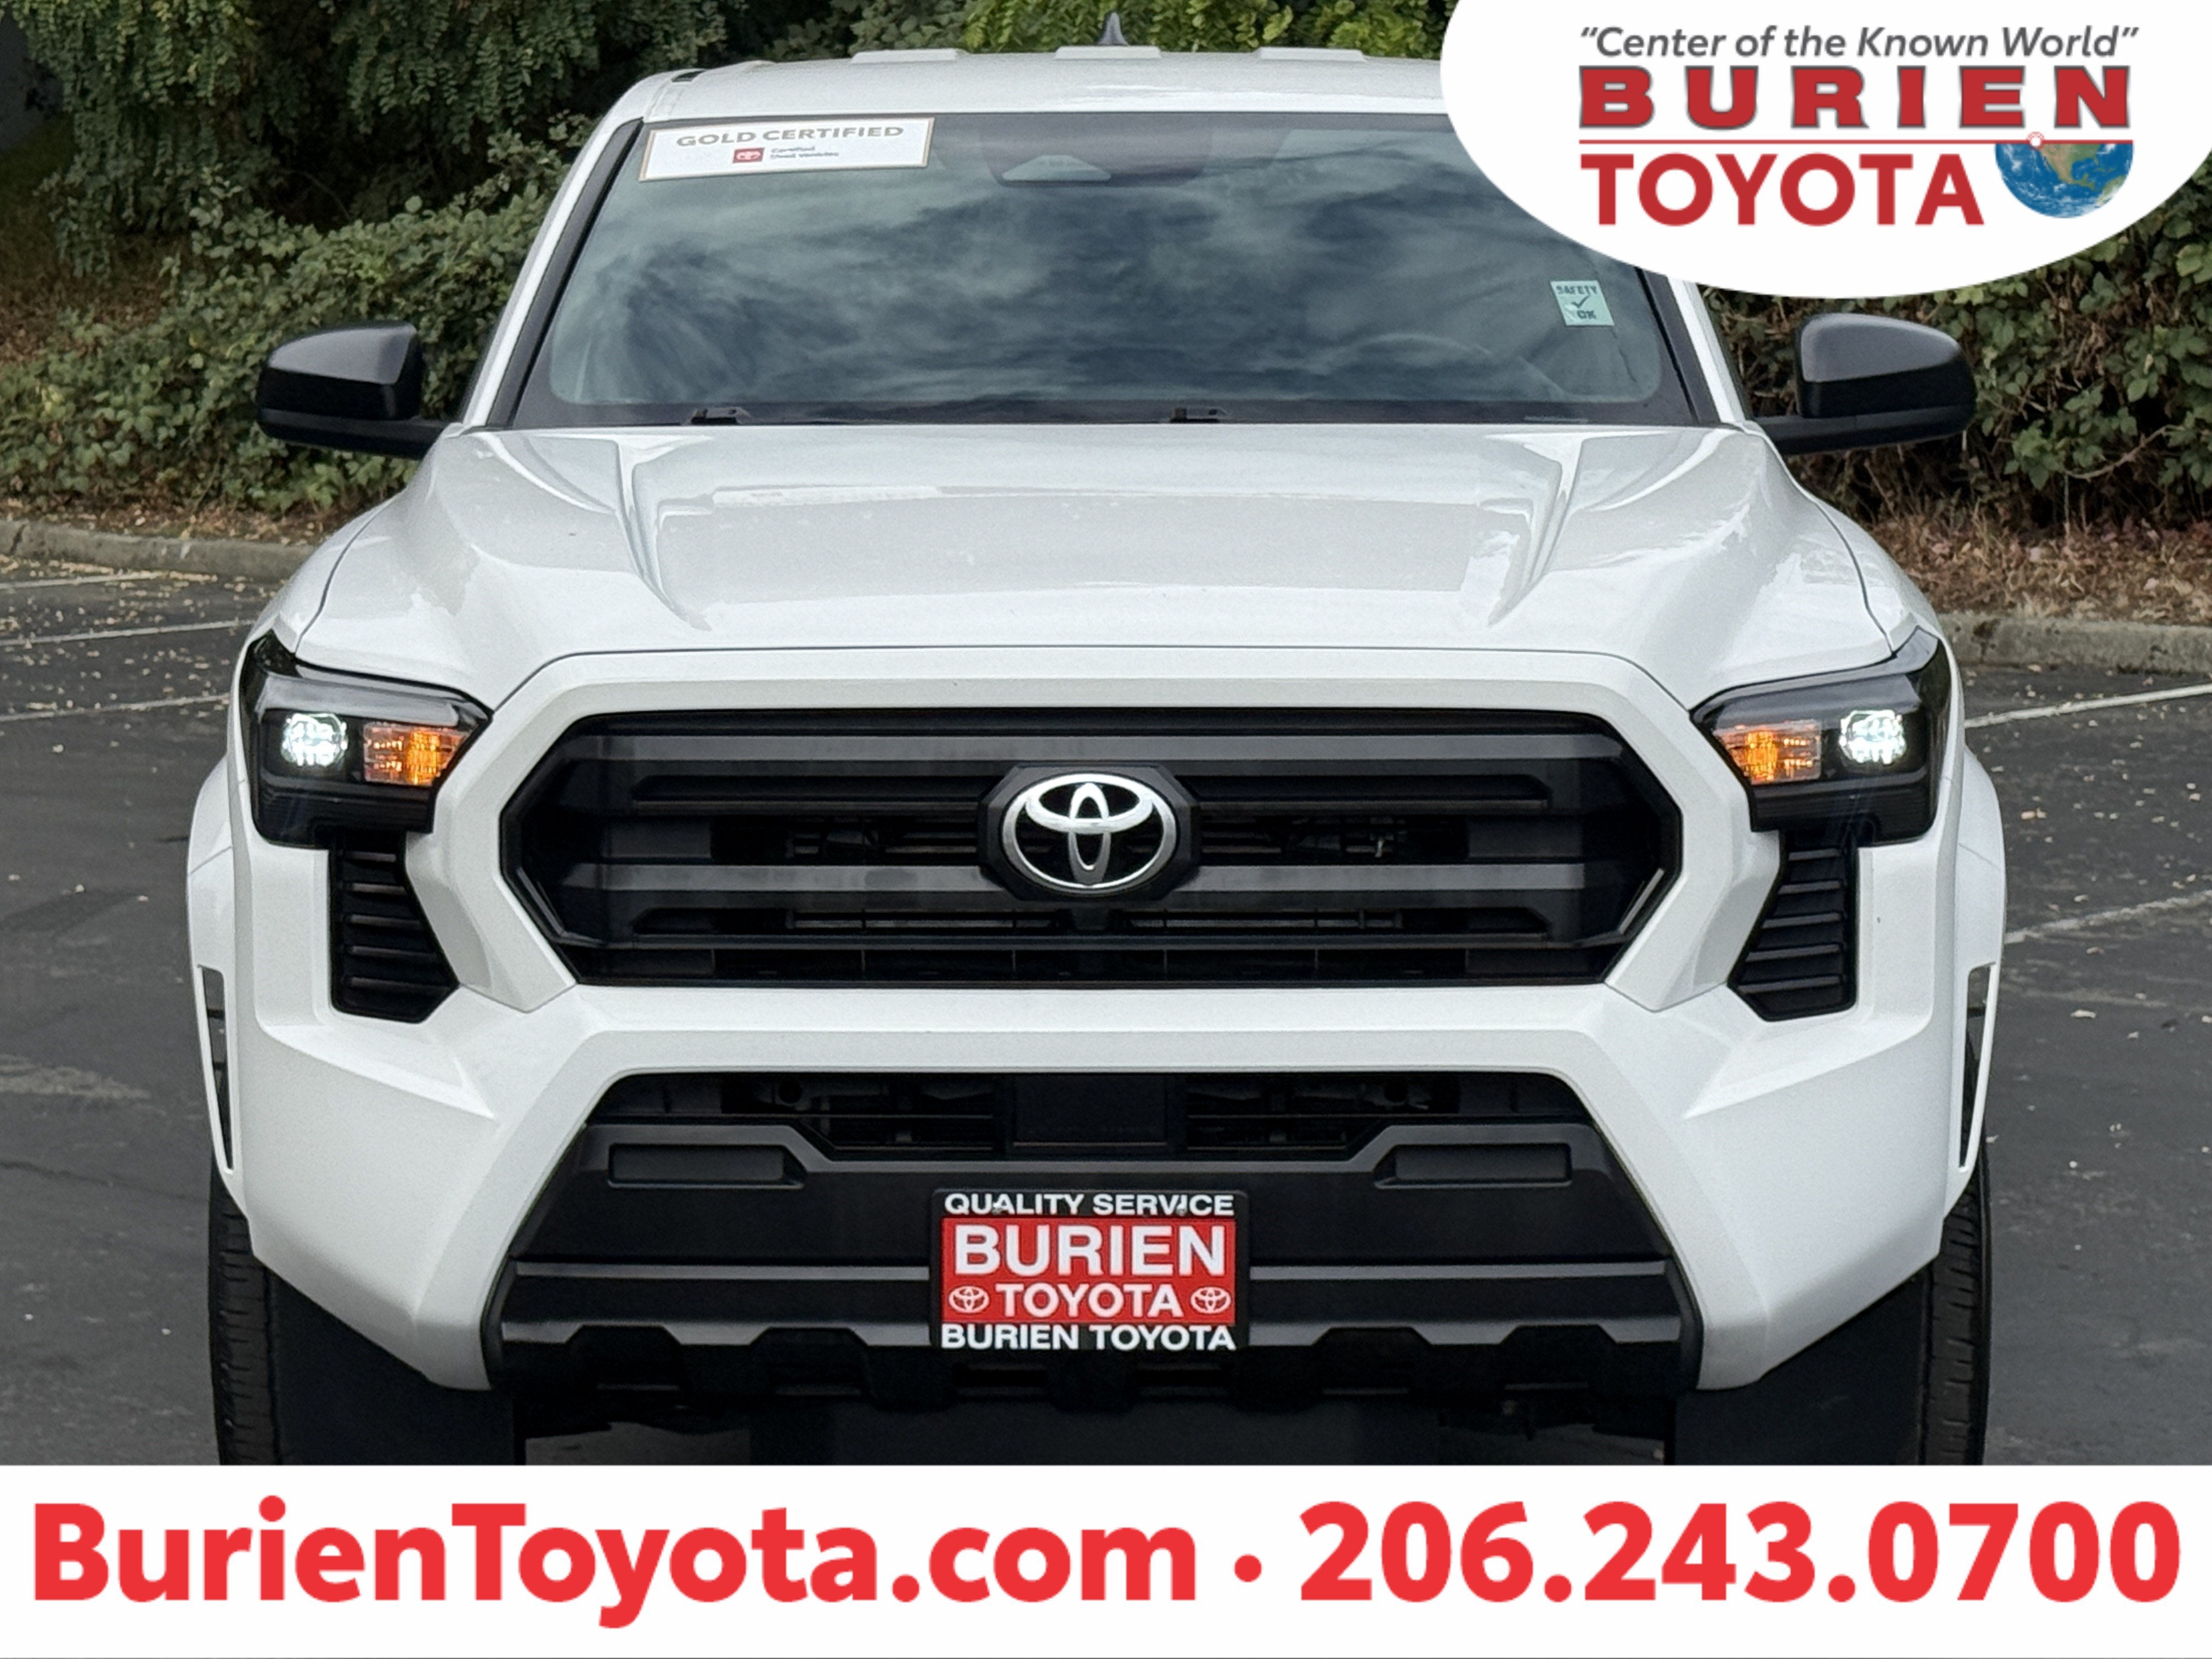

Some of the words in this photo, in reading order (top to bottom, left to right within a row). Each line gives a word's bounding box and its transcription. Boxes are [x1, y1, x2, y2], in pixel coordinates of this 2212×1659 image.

[676, 131, 757, 146] GOLD
[763, 127, 904, 141] CERTIFIED
[1556, 285, 1598, 295] SAFETY
[1577, 310, 1596, 319] OK
[945, 1193, 1084, 1215] QUALITY
[1093, 1194, 1234, 1216] SERVICE
[955, 1224, 1225, 1276] BURIEN
[995, 1283, 1183, 1318] TOYOTA
[941, 1324, 1079, 1350] BURIEN
[1089, 1324, 1237, 1350] TOYOTA
